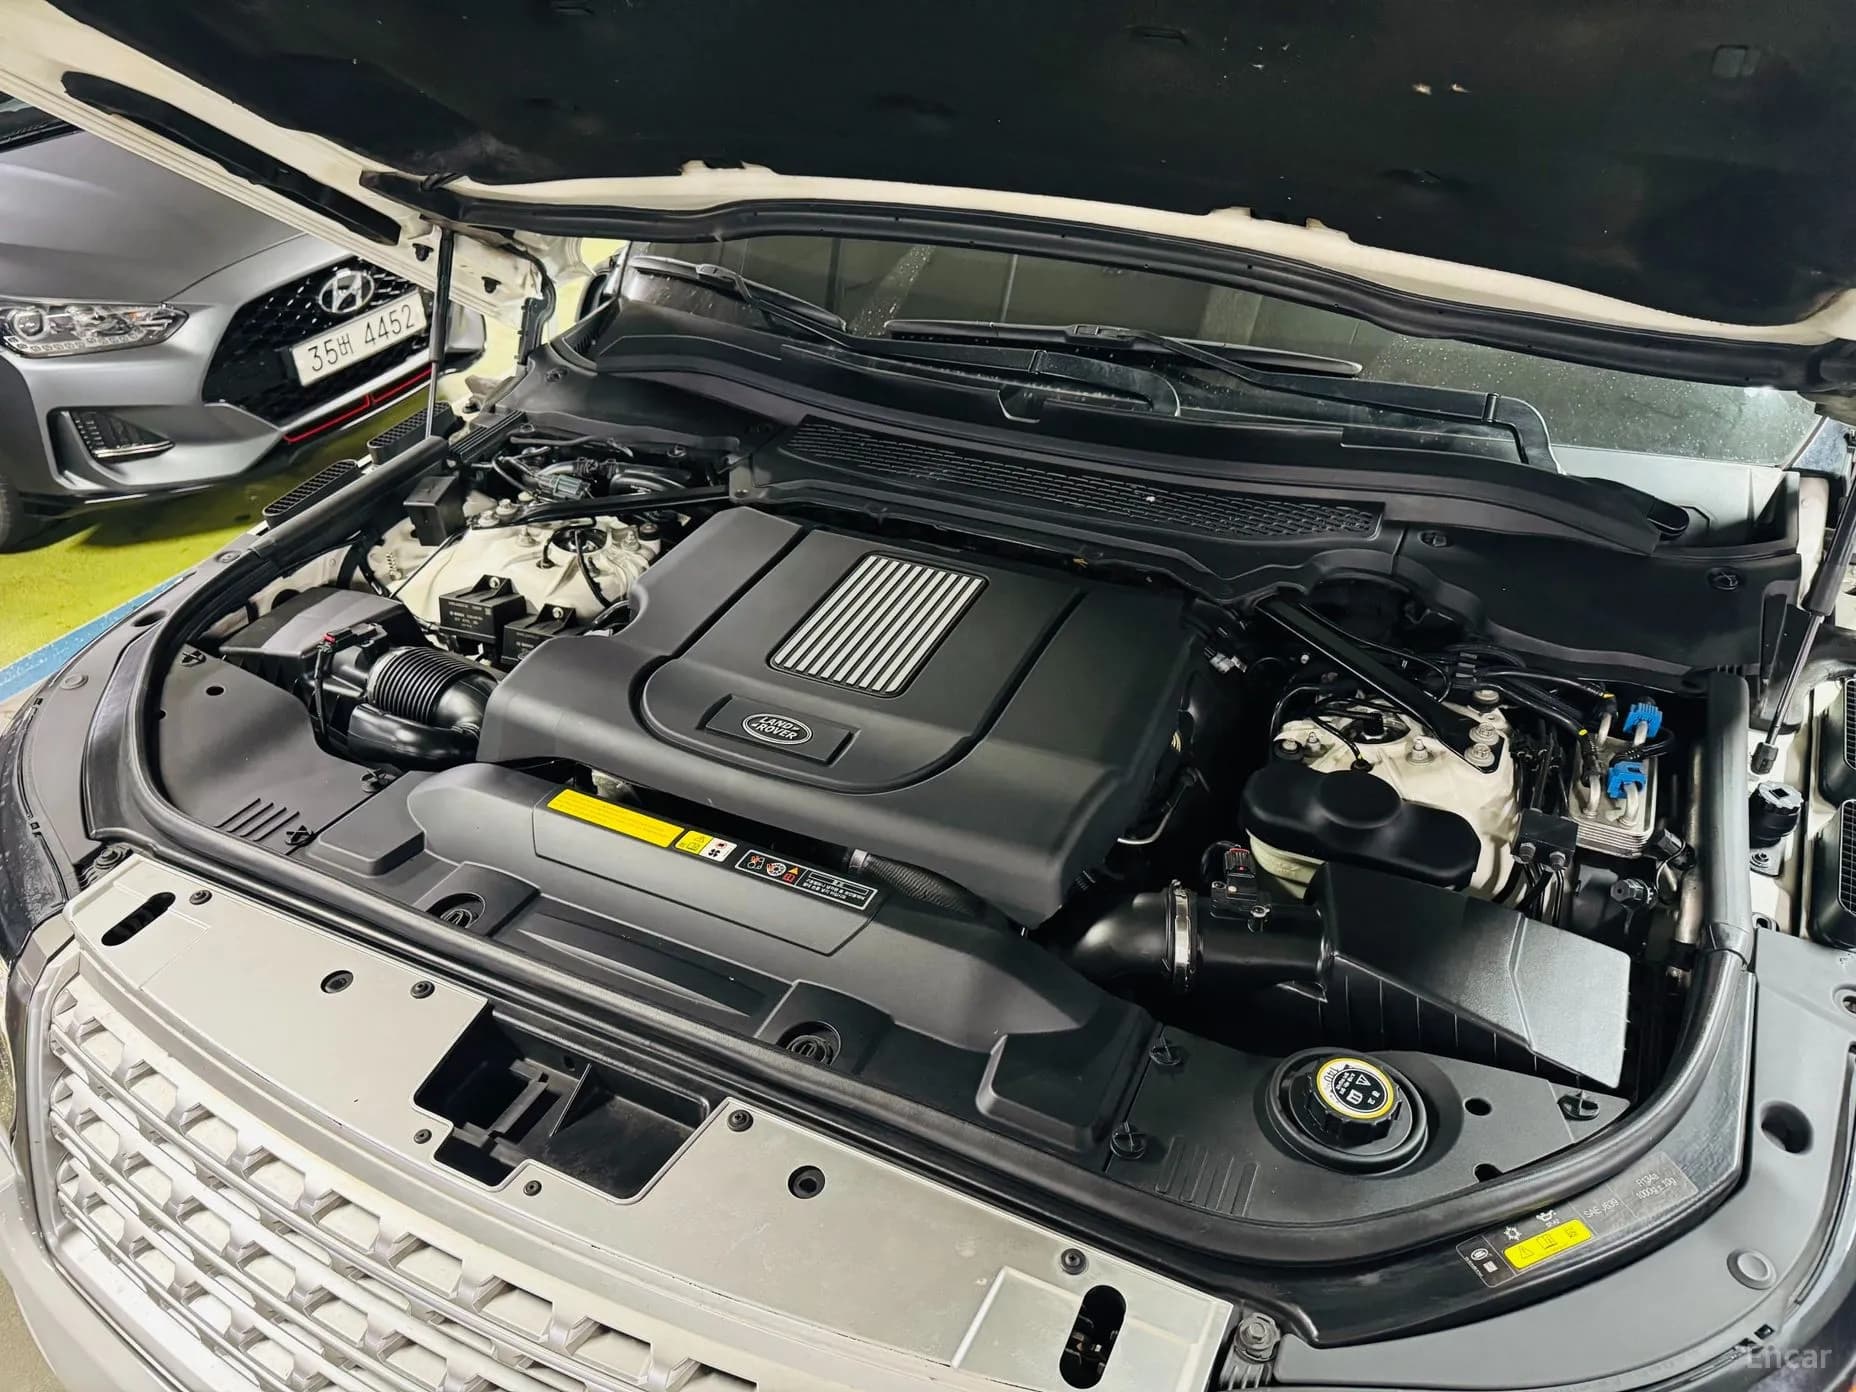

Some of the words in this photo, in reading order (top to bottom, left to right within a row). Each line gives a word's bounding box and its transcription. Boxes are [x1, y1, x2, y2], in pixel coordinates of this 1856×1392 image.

[307, 332, 354, 372] 35버
[364, 303, 416, 346] 4452
[756, 723, 799, 740] ROVER
[759, 716, 794, 730] LAND
